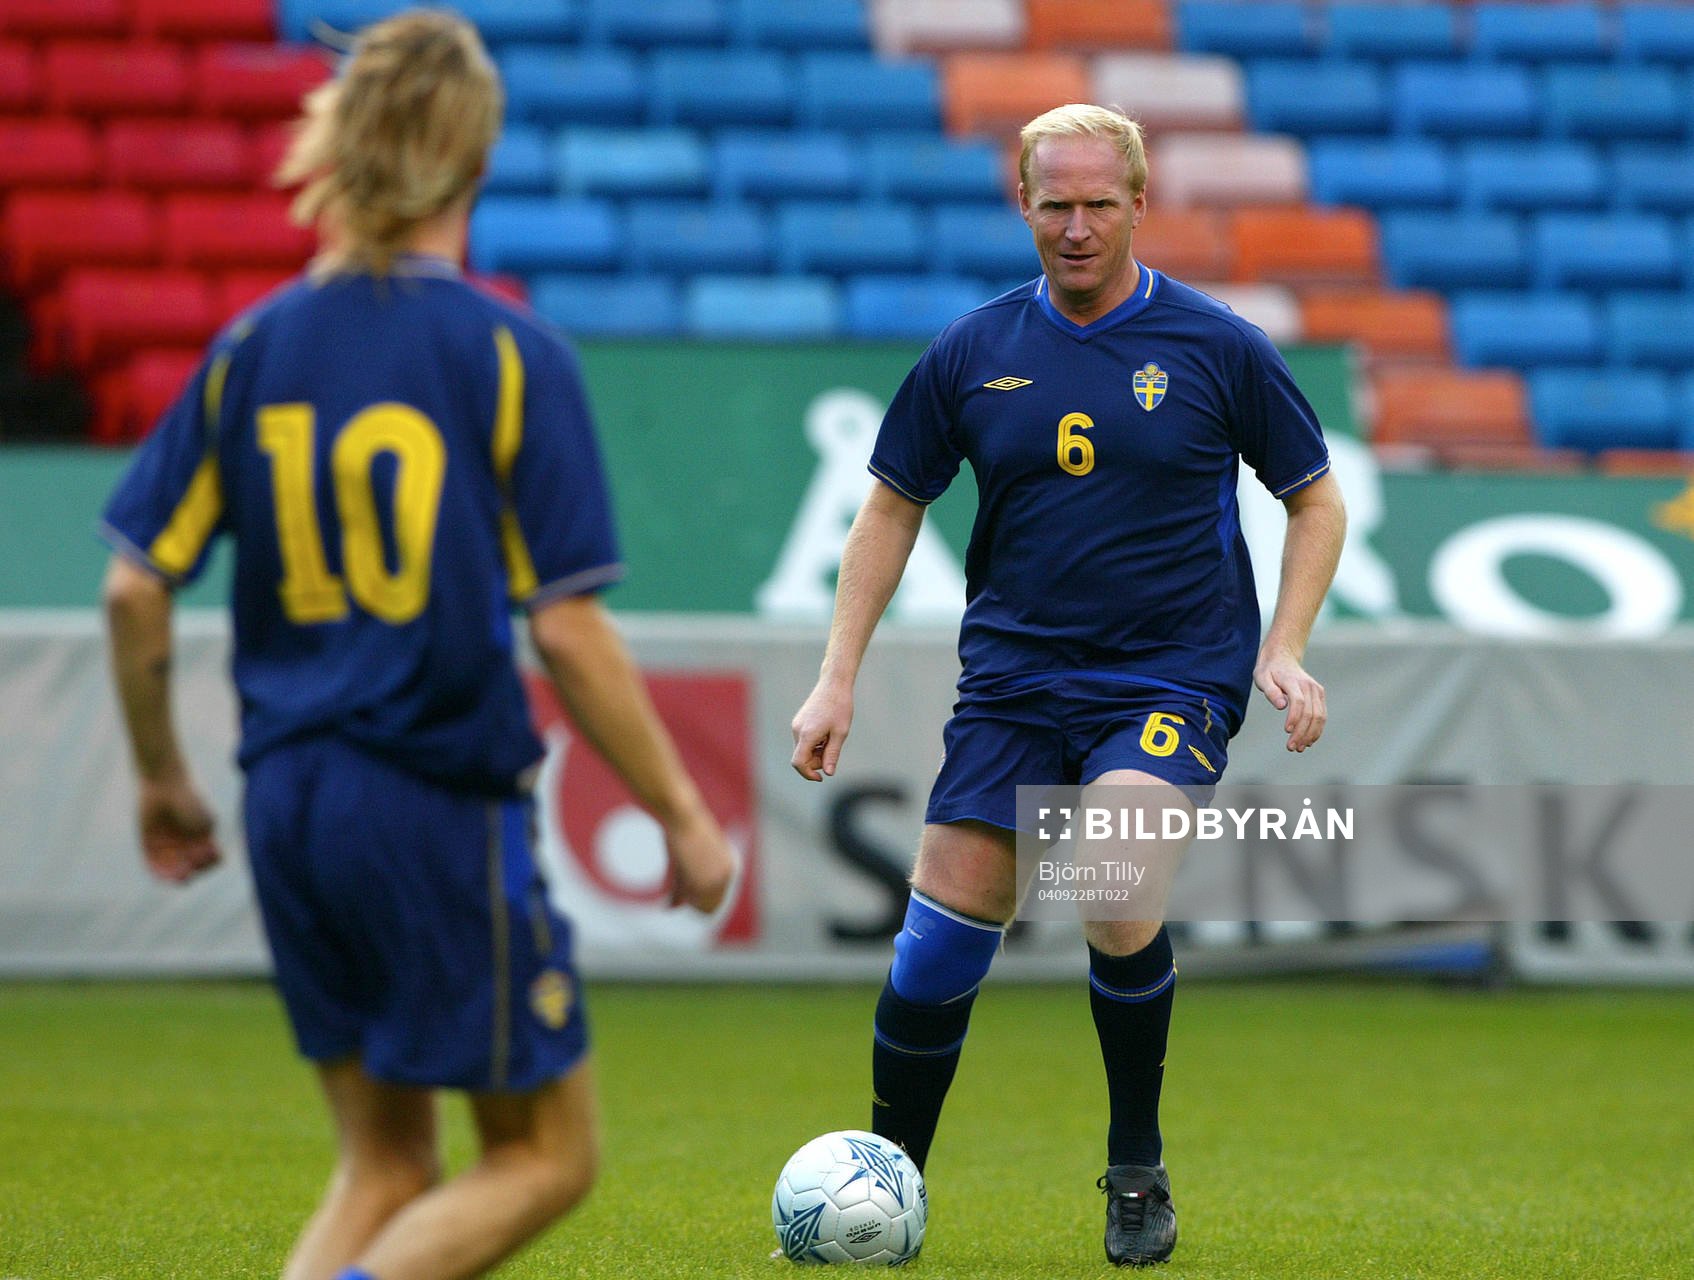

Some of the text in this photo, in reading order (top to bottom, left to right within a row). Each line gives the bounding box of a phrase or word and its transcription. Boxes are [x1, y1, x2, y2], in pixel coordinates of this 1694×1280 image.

[1057, 413, 1095, 476] 6
[256, 403, 446, 625] 10
[1140, 712, 1185, 756] 6
